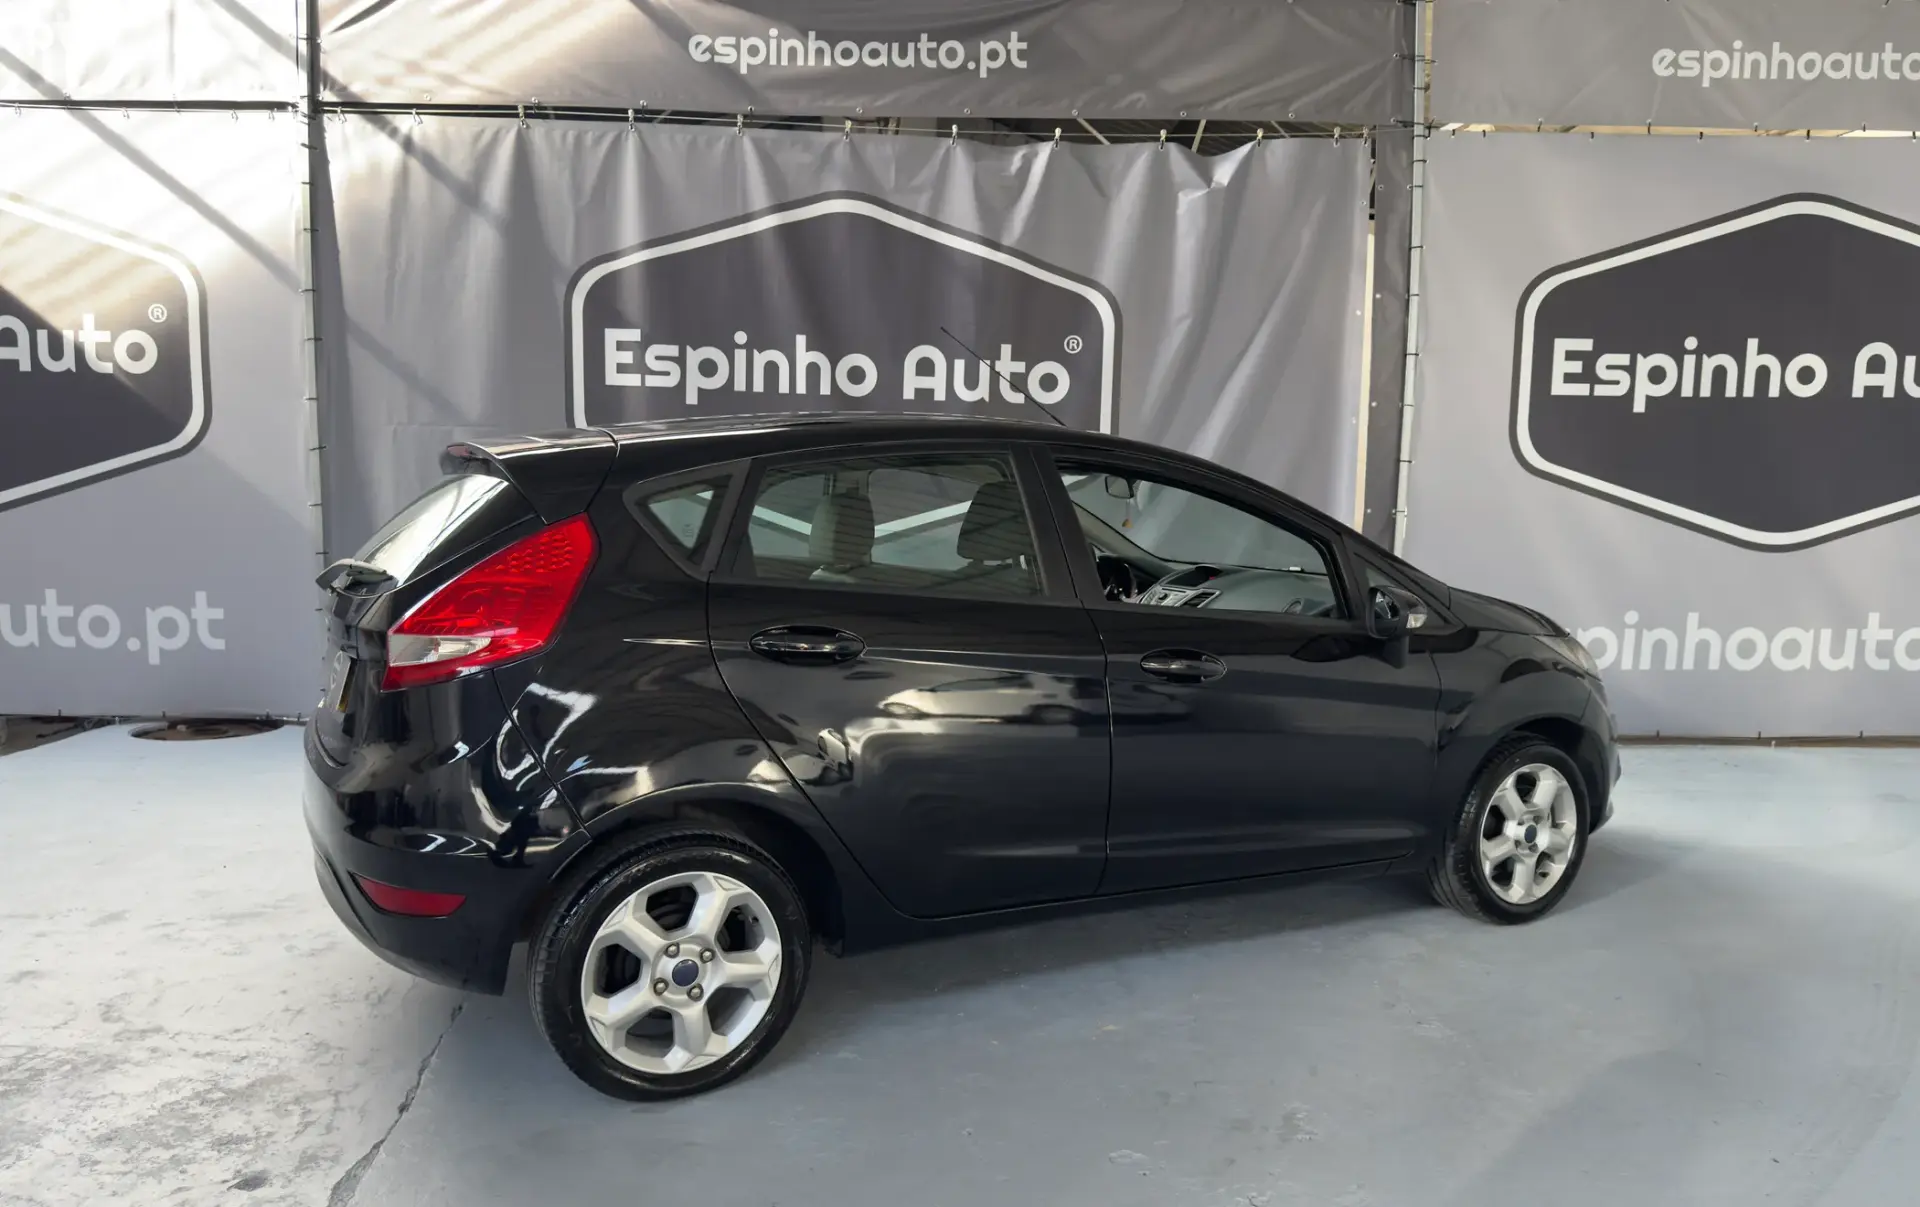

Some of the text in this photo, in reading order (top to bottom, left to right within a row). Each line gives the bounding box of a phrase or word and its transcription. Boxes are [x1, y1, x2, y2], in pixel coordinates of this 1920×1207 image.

[687, 28, 1028, 78] espinhoauto.pt
[604, 327, 878, 405] Espinho
[902, 343, 1071, 404] Auto
[1551, 336, 1828, 413] Espinho
[1565, 610, 1920, 671] pinhoauto
